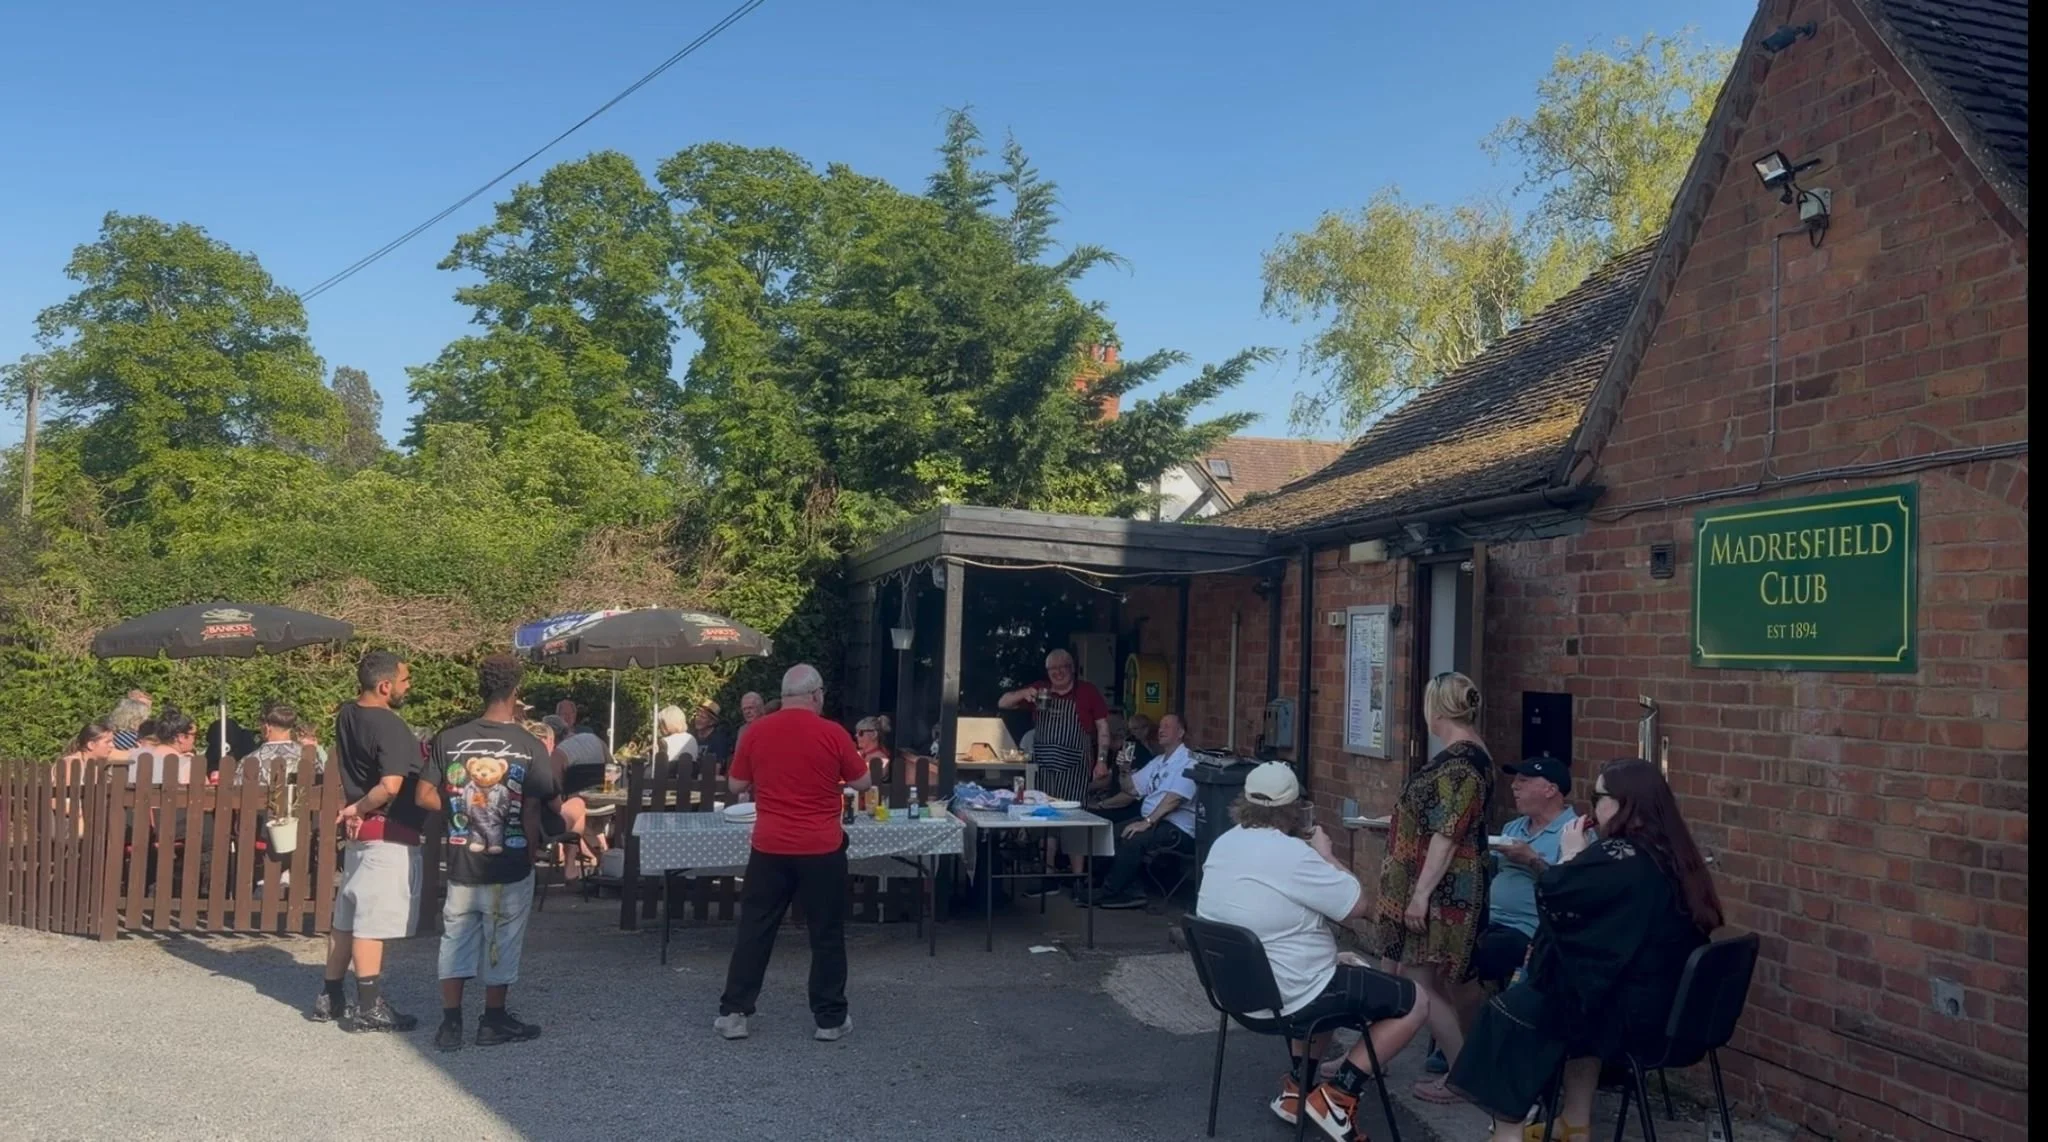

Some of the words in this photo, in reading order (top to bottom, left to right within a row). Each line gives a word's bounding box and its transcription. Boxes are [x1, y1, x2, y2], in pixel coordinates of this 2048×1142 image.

[1710, 523, 1893, 566] MADRESFIELD
[1760, 571, 1828, 606] CLUB
[1767, 624, 1787, 639] EST
[1790, 622, 1818, 639] 1894
